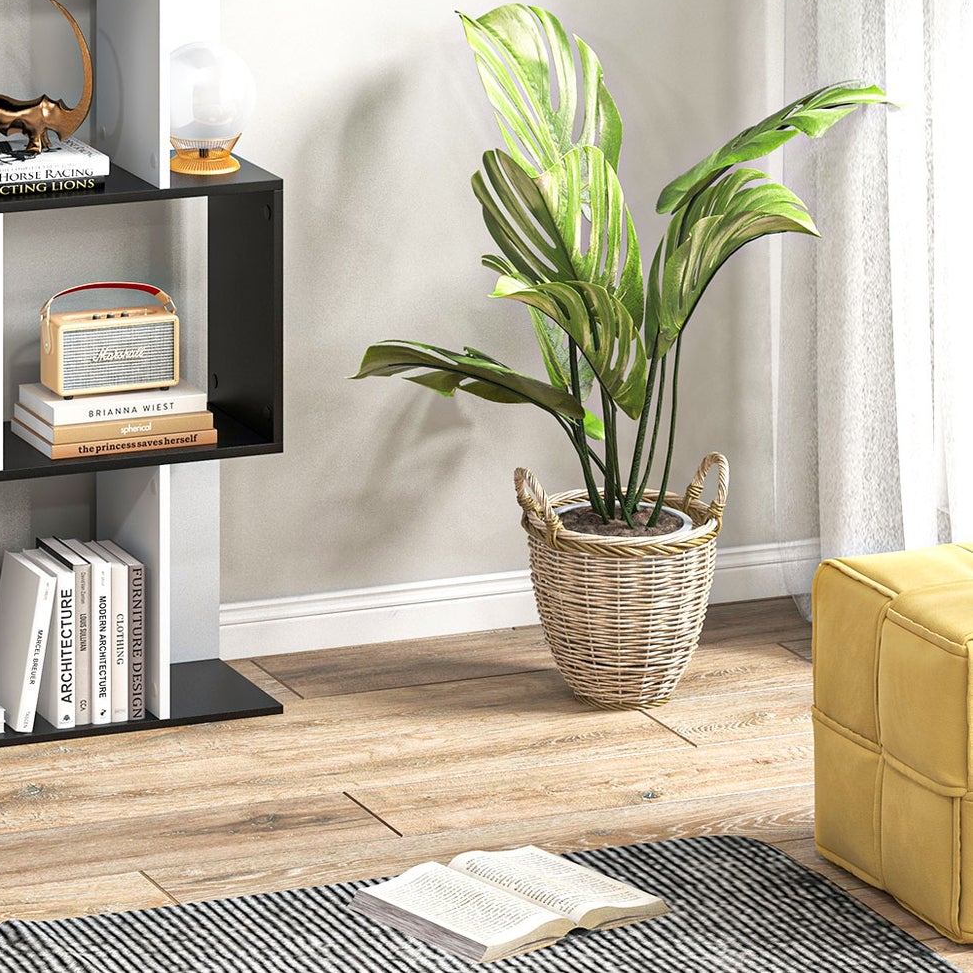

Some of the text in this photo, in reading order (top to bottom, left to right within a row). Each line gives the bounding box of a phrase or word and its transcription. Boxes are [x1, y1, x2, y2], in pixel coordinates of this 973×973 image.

[0, 171, 41, 183] HORSE
[45, 168, 94, 179] RACING
[51, 178, 95, 190] LIONS
[88, 402, 175, 418] BRIANNA WIEST
[120, 421, 152, 435] spherical
[78, 434, 199, 454] the princess saves herself
[79, 613, 87, 652] LOUIS SULLIVAN
[98, 595, 107, 632] MODERN
[29, 629, 44, 685] MARCEL BREUER
[60, 588, 73, 703] ARCHITECTURE
[116, 613, 125, 665] CLOTHING
[132, 568, 143, 719] FURNITURE DESIGN
[98, 634, 107, 698] ARCHITECTURE
